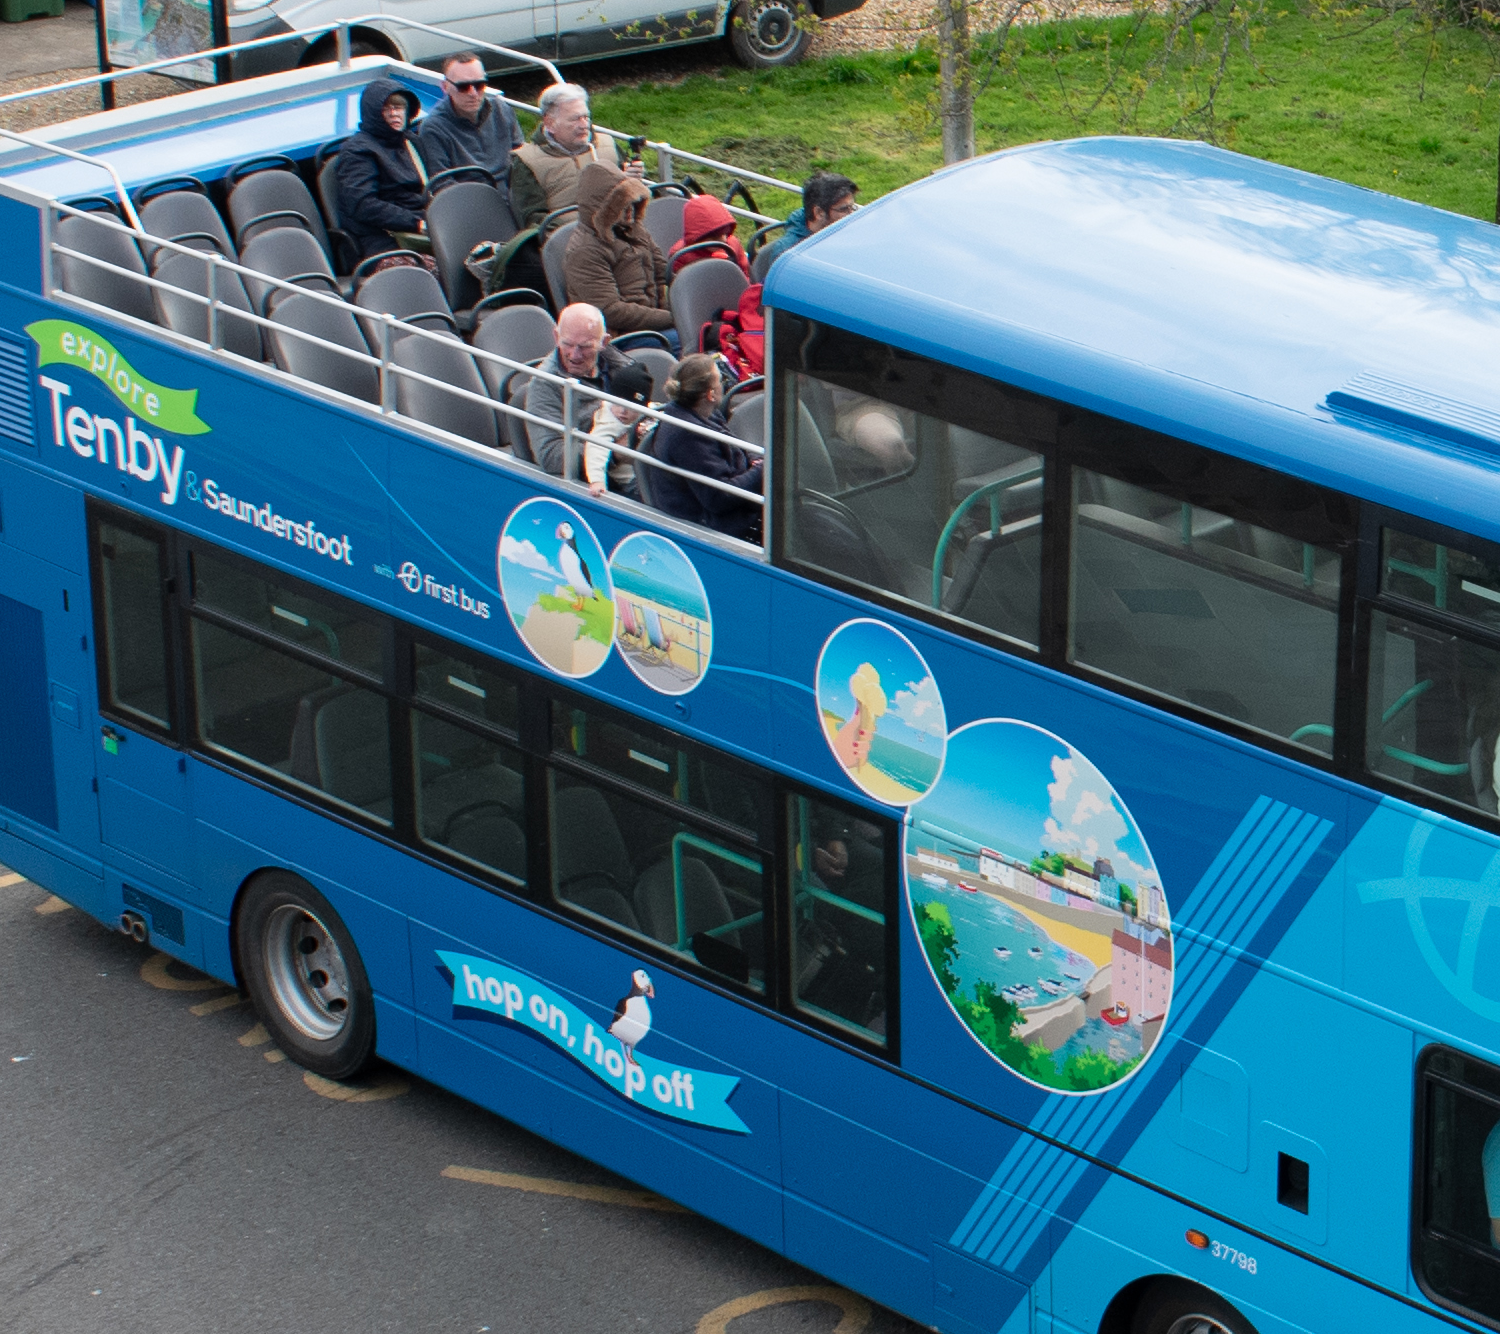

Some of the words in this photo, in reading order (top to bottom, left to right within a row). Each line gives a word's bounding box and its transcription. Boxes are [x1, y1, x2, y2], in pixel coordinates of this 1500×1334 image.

[59, 329, 161, 417] explore
[39, 374, 186, 506] Tenby
[185, 469, 203, 504] &
[202, 478, 355, 566] Saundersfoot
[462, 963, 524, 1020] hop
[528, 993, 577, 1048] on,
[583, 1022, 647, 1099] hop
[652, 1069, 695, 1111] off
[1211, 1239, 1258, 1276] 37798
